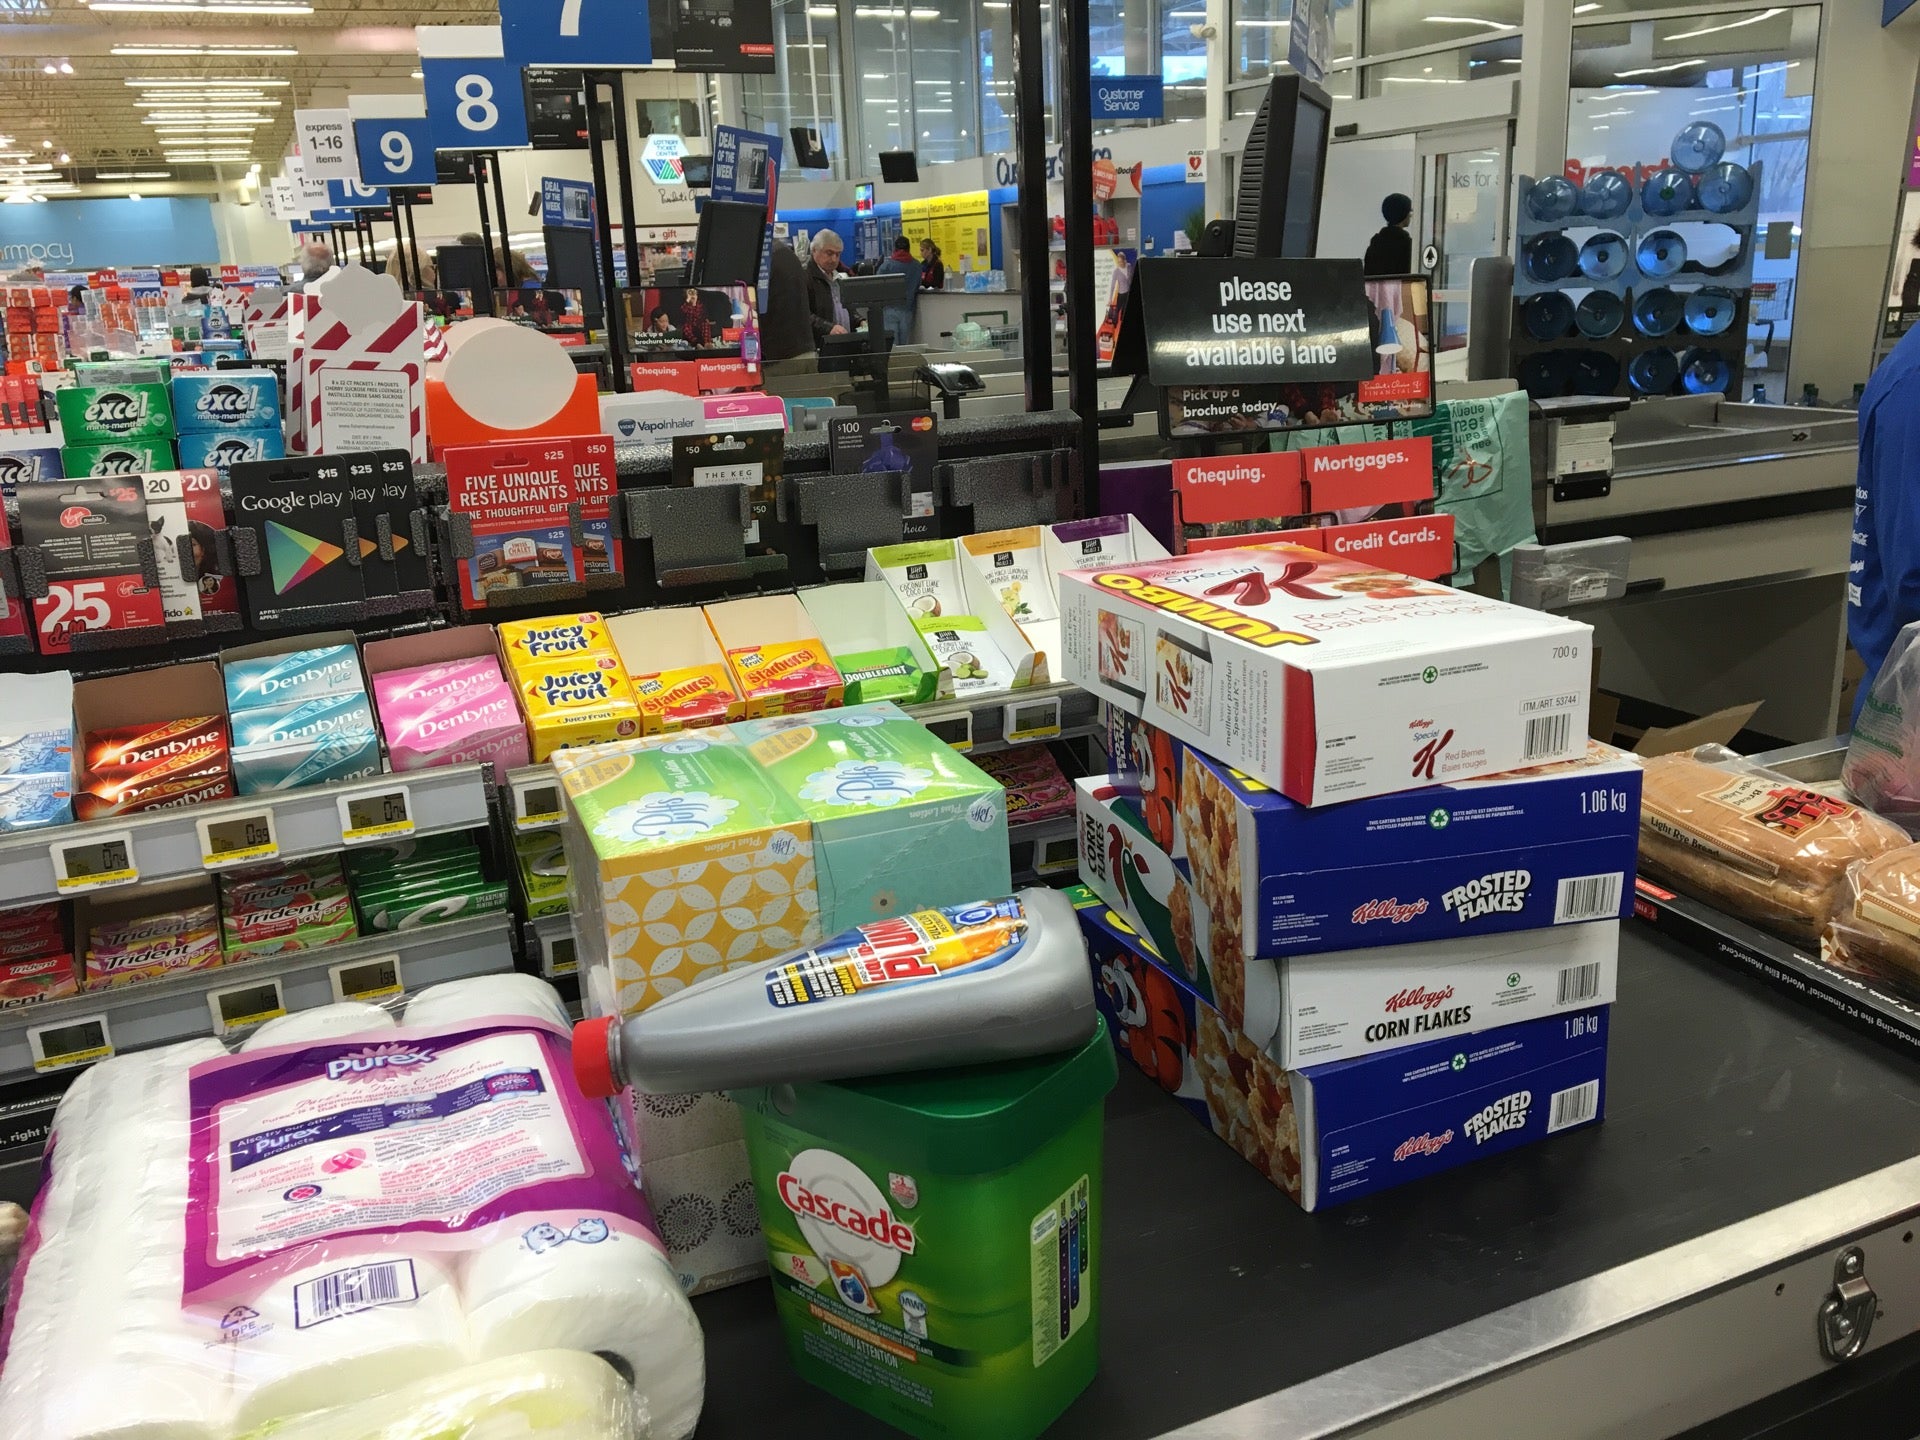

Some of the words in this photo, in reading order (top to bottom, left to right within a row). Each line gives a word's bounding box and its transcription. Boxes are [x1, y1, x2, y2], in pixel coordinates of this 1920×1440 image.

[454, 74, 499, 131] 8
[1098, 88, 1145, 101] Customer
[1103, 98, 1140, 111] Service
[305, 123, 343, 132] express
[309, 136, 343, 150] 1-16
[719, 132, 736, 149] DEAL
[315, 155, 342, 164] items
[380, 131, 413, 173] 9
[717, 150, 725, 162] OF
[725, 151, 735, 162] THE
[716, 164, 734, 179] WEEK
[545, 201, 561, 211] WEEK
[662, 229, 677, 239] gift
[1219, 276, 1292, 306] please
[1212, 312, 1252, 333] use
[1258, 309, 1306, 333] next
[1186, 341, 1285, 366] available
[1290, 340, 1337, 364] lane
[196, 384, 260, 412] excel
[1183, 388, 1209, 401] Pick
[1213, 391, 1228, 403] up
[1231, 389, 1240, 398] a
[85, 391, 148, 422] excel
[1183, 402, 1238, 417] brochure
[1242, 401, 1280, 415] today.
[837, 422, 860, 433] $100
[204, 439, 264, 468] excel
[543, 450, 564, 461] $25
[586, 444, 607, 454] $50
[686, 446, 700, 454] $50
[90, 449, 151, 477] excel
[350, 464, 373, 477] $25
[382, 461, 404, 474] $25
[1313, 451, 1410, 473] Mortgages.
[317, 468, 338, 481] $15
[465, 476, 498, 491] FIVE
[503, 469, 560, 488] UNIQUE
[705, 471, 726, 480] THE
[730, 469, 753, 478] KEG
[1187, 465, 1266, 485] Chequing.
[109, 486, 138, 502] $25
[241, 492, 306, 513] Google
[308, 489, 343, 508] play
[459, 484, 568, 507] RESTAURANTS
[485, 505, 547, 519] THOUGHTFUL
[753, 505, 767, 513] $50
[82, 516, 104, 524] mobile
[591, 522, 607, 530] $50
[548, 531, 565, 540] $25
[1334, 530, 1384, 552] Credit
[1388, 527, 1441, 547] Cards.
[508, 545, 531, 555] CHALET
[531, 570, 568, 579] milestones
[1164, 565, 1261, 583] Special
[900, 581, 924, 593] COCONUT
[925, 579, 940, 588] LIME
[905, 589, 921, 597] COCO
[35, 582, 111, 633] 25
[164, 606, 183, 618] fido
[1092, 573, 1321, 647] JUMBO
[1293, 607, 1363, 622] Red
[1365, 598, 1478, 612] Berries
[1303, 614, 1398, 632] Baies
[1401, 602, 1512, 620] rouges
[521, 624, 584, 645] Juicy
[529, 636, 589, 657] Fruit
[1552, 647, 1568, 659] 700
[1571, 648, 1578, 660] g
[740, 653, 760, 665] Juicy
[744, 658, 765, 669] Fruit
[748, 650, 814, 684] Starburst
[260, 657, 353, 695] Dentyne
[538, 670, 603, 691] Juicy
[844, 664, 907, 685] DOUBLEMINT
[637, 679, 659, 690] Juicy
[642, 685, 662, 696] Fruit
[642, 675, 715, 711] Starburst
[546, 684, 608, 708] Fruit
[1556, 694, 1577, 706] 53744
[268, 706, 366, 743] Dentyne
[417, 696, 508, 739] Dentyne
[562, 714, 586, 724] Juicy
[587, 711, 612, 720] Fruit
[1232, 698, 1240, 737] Special
[1408, 718, 1435, 729] Kellogg's
[1413, 729, 1440, 742] Special
[120, 729, 220, 766] Dentyne
[1412, 728, 1455, 779] K
[1444, 752, 1460, 761] Red
[1461, 747, 1485, 758] Berries
[1441, 762, 1461, 772] Baies
[1462, 757, 1488, 771] rouges
[836, 765, 914, 801] Puffs
[1580, 791, 1607, 814] 1.06
[1611, 790, 1627, 813] kg
[1733, 787, 1762, 807] Bread
[910, 808, 937, 819] Lotion
[938, 803, 963, 815] Plus
[1650, 815, 1671, 835] Light
[1671, 827, 1691, 844] Rye
[705, 841, 733, 852] Lotion
[736, 837, 763, 848] Plus
[1086, 812, 1098, 873] CORN
[1096, 821, 1107, 883] FLAKES
[1441, 869, 1532, 912] FROSTED
[243, 902, 321, 927] Trident
[296, 901, 348, 926] Layers
[1351, 897, 1430, 924] Kellogg's
[1457, 891, 1525, 924] FLAKES
[919, 914, 935, 926] CLOG
[927, 926, 943, 939] FULL
[106, 944, 191, 971] Trident
[162, 944, 217, 970] Layers
[10, 959, 58, 976] Trident
[1764, 964, 1781, 979] Elite
[1781, 972, 1806, 991] World
[774, 990, 786, 1005] BEST
[1385, 985, 1455, 1013] Kellogg's
[1847, 1004, 1859, 1017] PC
[1860, 1012, 1875, 1025] the
[1364, 1017, 1410, 1043] CORN
[1414, 1005, 1473, 1034] FLAKES
[1565, 1017, 1585, 1040] 1.06
[1586, 1014, 1598, 1034] kg
[327, 1048, 436, 1080] Purex
[491, 1076, 531, 1089] Purex
[1463, 1089, 1532, 1138] FROSTED
[10, 1127, 41, 1143] right
[237, 1135, 263, 1148] Also
[265, 1129, 281, 1140] try
[284, 1124, 305, 1133] our
[307, 1115, 338, 1128] other
[1475, 1110, 1527, 1146] FLAKES
[256, 1124, 322, 1153] Purex
[263, 1136, 314, 1158] products
[1393, 1129, 1455, 1162] Kellogg's
[777, 1172, 914, 1253] Cascade
[822, 1322, 899, 1369] CAUTION/ATTENTION
